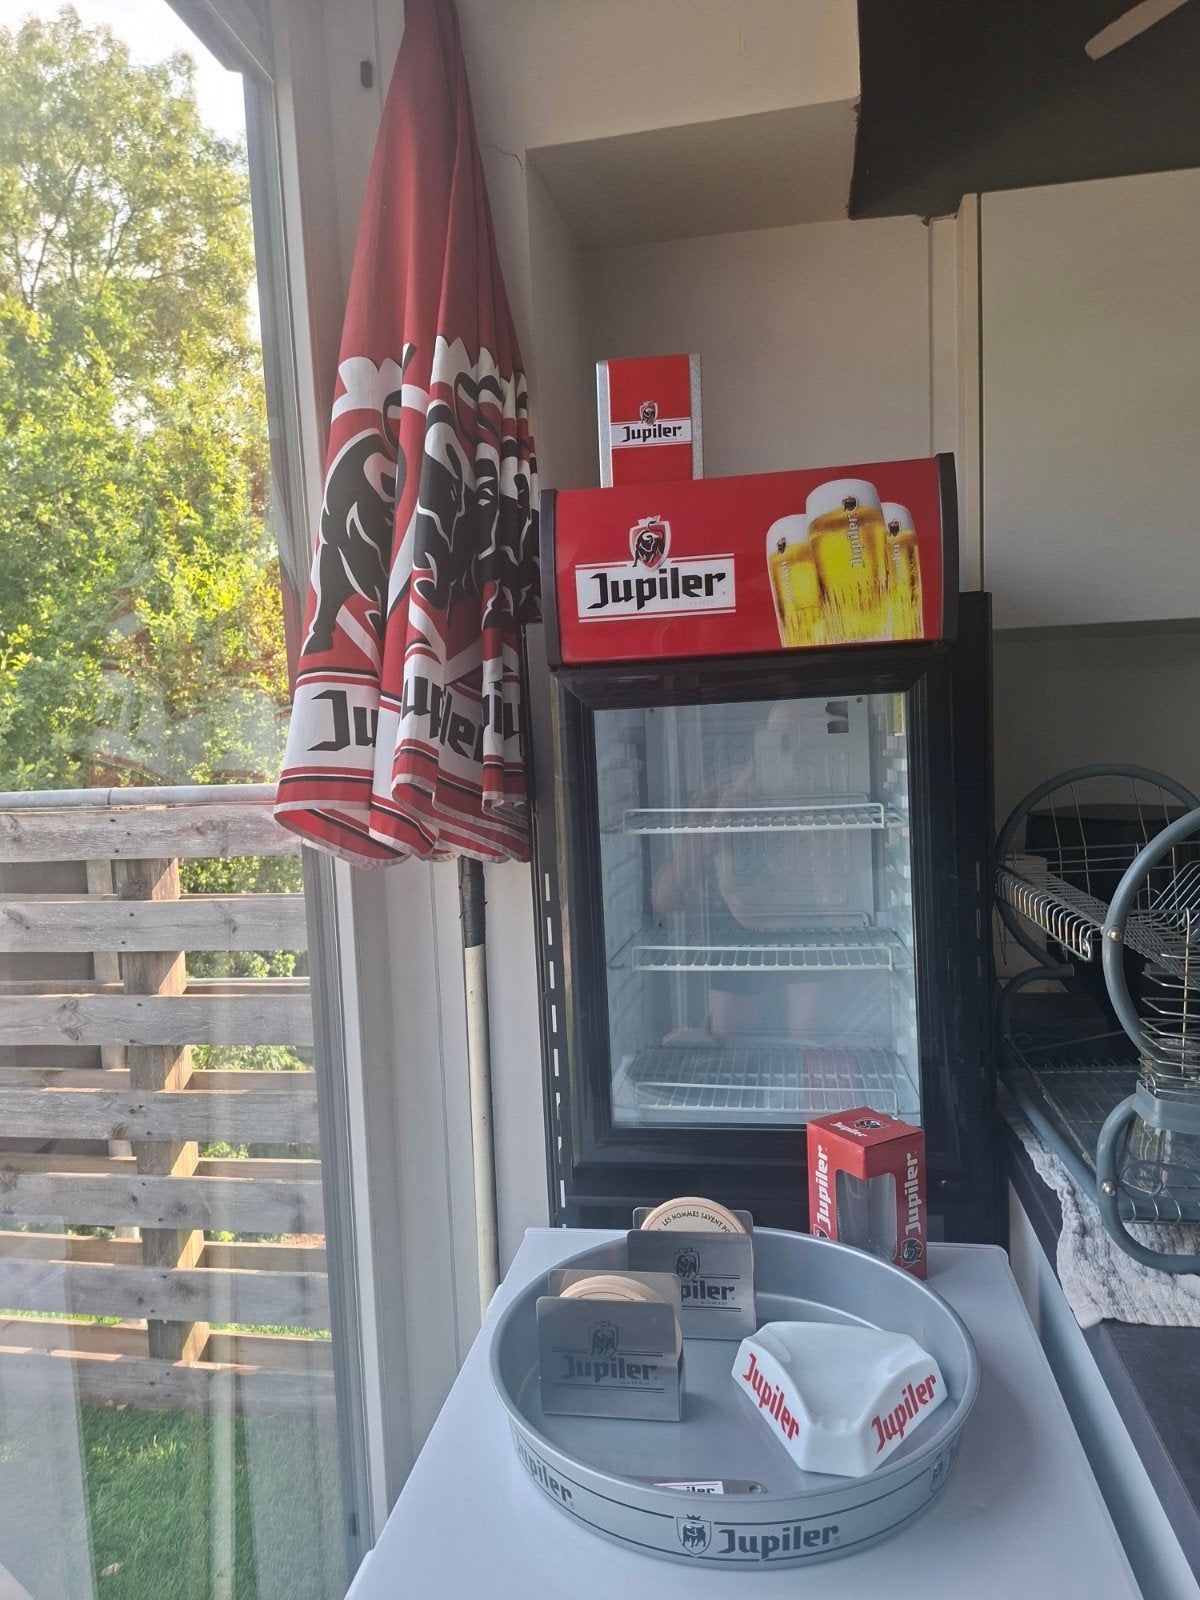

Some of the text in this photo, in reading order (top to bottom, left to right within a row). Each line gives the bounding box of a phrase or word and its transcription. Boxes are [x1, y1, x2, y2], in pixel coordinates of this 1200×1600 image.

[621, 424, 682, 443] Jupiler
[846, 513, 866, 569] Jupiler
[587, 567, 726, 611] Jupiler
[815, 1144, 832, 1234] Jupiler
[904, 1152, 922, 1237] Jupiler
[661, 1216, 672, 1227] LES
[671, 1210, 700, 1221] HOMMES
[700, 1212, 723, 1228] SAVENT
[682, 1280, 736, 1300] piler
[561, 1354, 658, 1384] Jupiler
[742, 1352, 800, 1441] Jupiler
[870, 1374, 937, 1454] Jupiler
[717, 1525, 840, 1560] Jupiler
